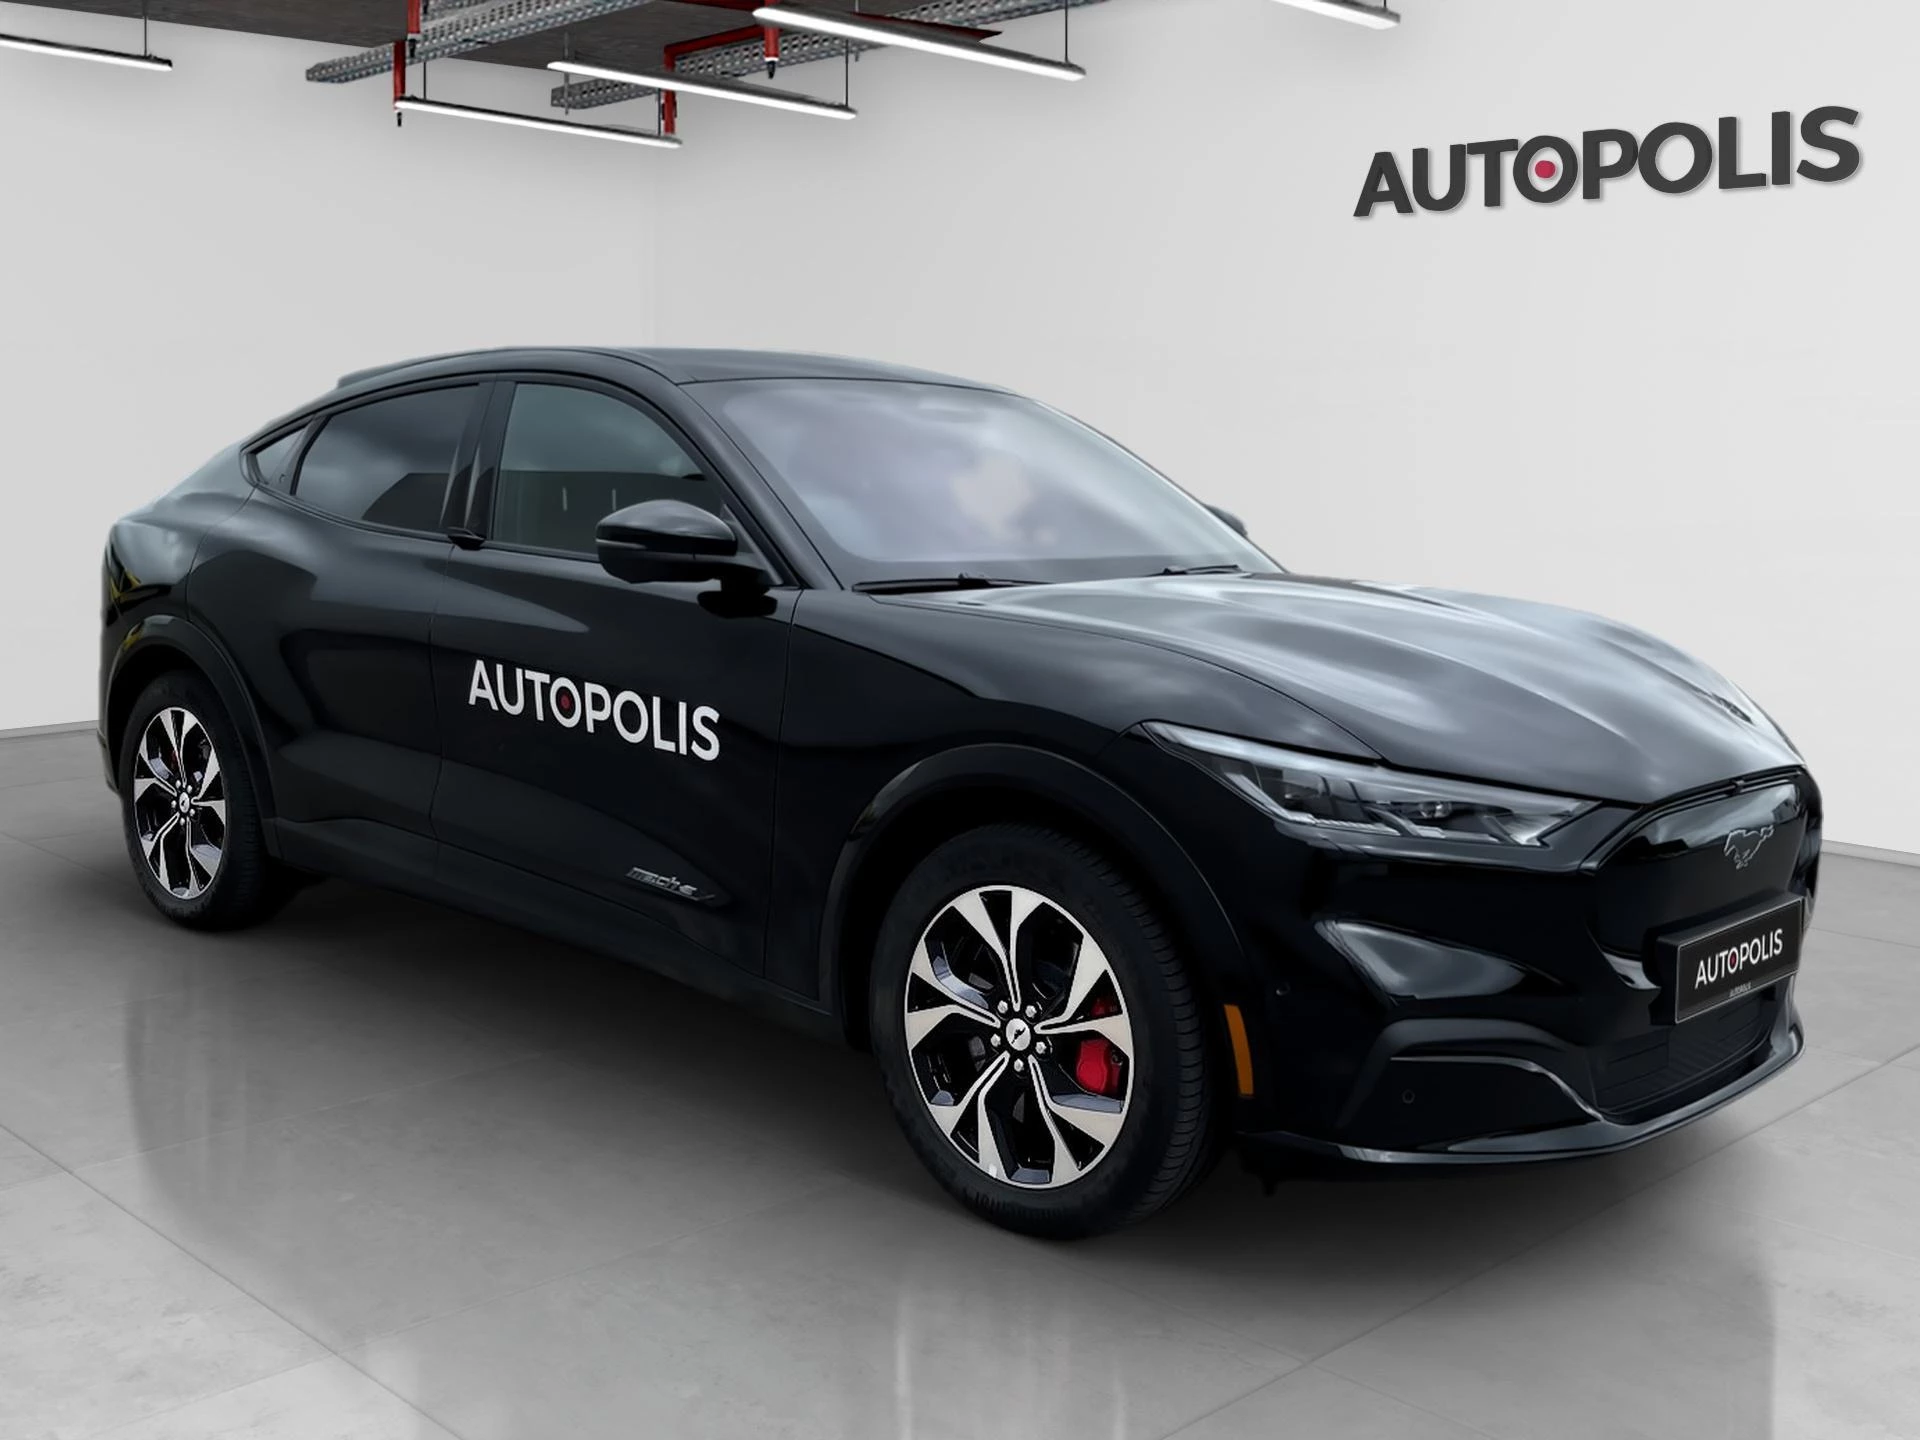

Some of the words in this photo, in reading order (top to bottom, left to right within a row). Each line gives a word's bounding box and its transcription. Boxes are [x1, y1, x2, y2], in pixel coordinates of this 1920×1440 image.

[1353, 105, 1861, 217] AUTOPOLIS
[468, 659, 720, 761] AUTOPOLIS
[1694, 928, 1784, 990] AUTOPOLIS
